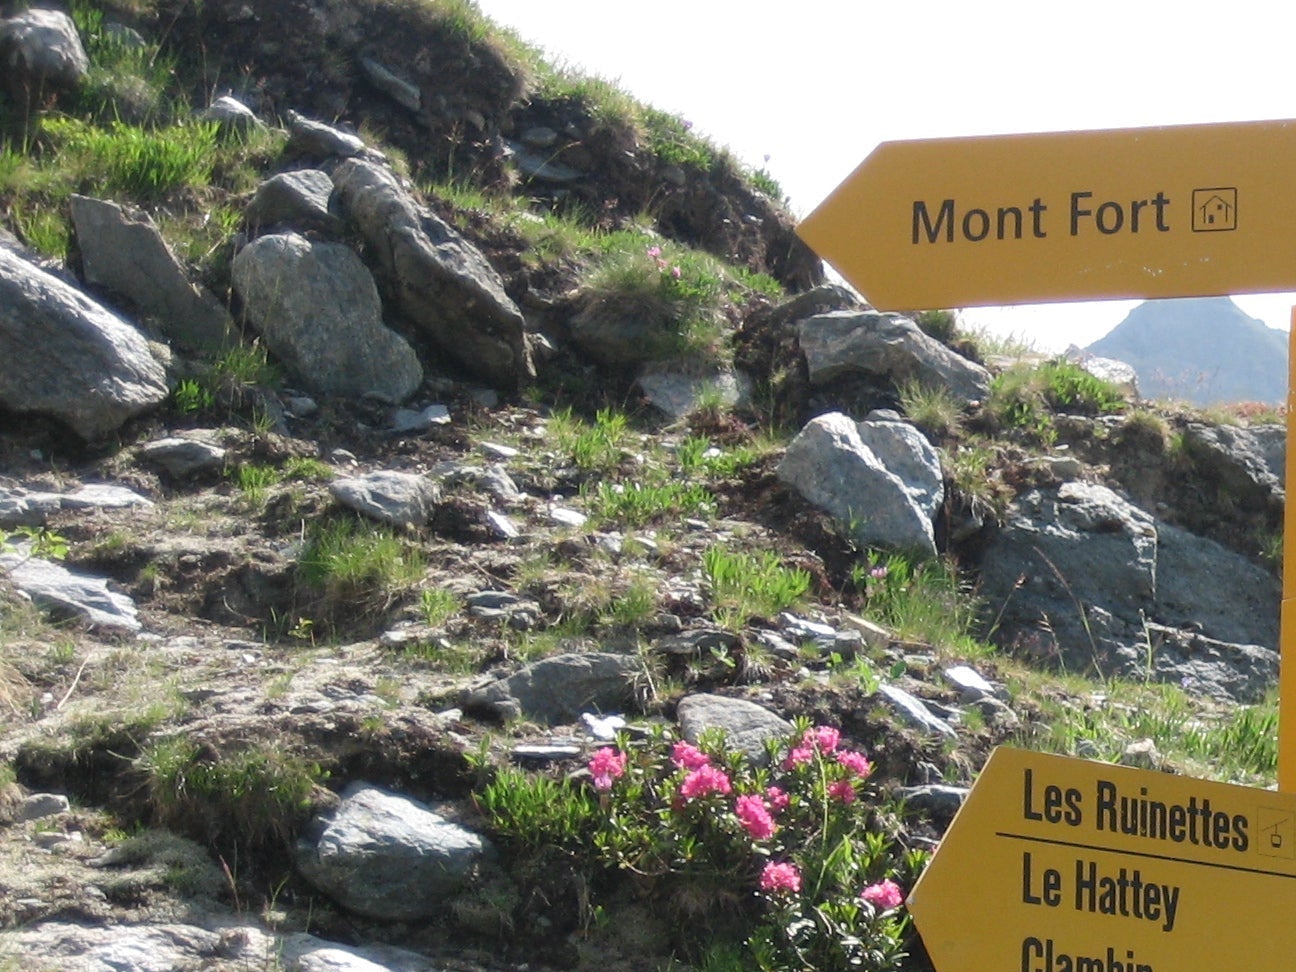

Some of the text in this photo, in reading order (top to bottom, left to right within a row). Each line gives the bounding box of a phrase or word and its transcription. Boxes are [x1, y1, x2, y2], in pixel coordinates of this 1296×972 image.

[911, 191, 1171, 245] Mont Fort
[1023, 768, 1250, 853] Les Ruinettes
[1022, 851, 1180, 932] Le Hattey
